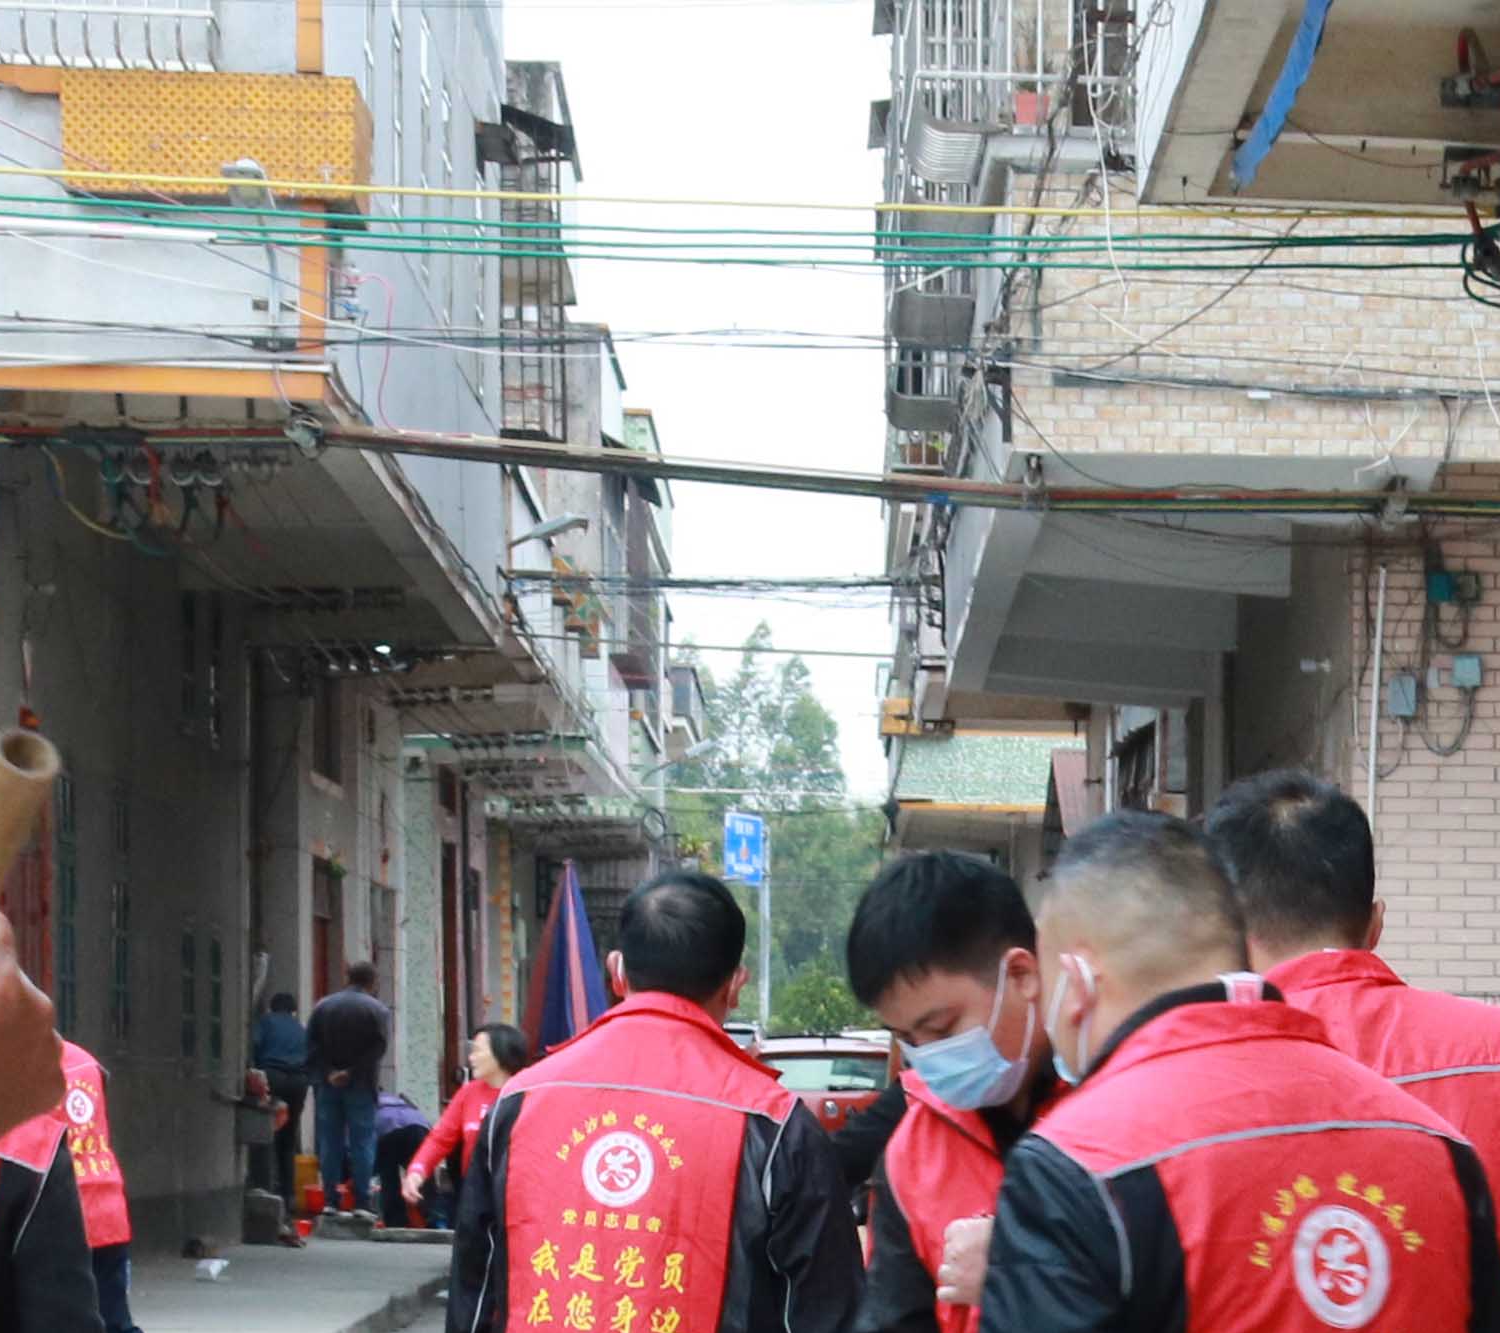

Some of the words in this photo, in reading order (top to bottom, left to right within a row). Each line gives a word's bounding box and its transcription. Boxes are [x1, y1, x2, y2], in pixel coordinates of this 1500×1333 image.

[561, 1208, 662, 1233] 党员志愿者
[530, 1238, 686, 1294] 我是党员
